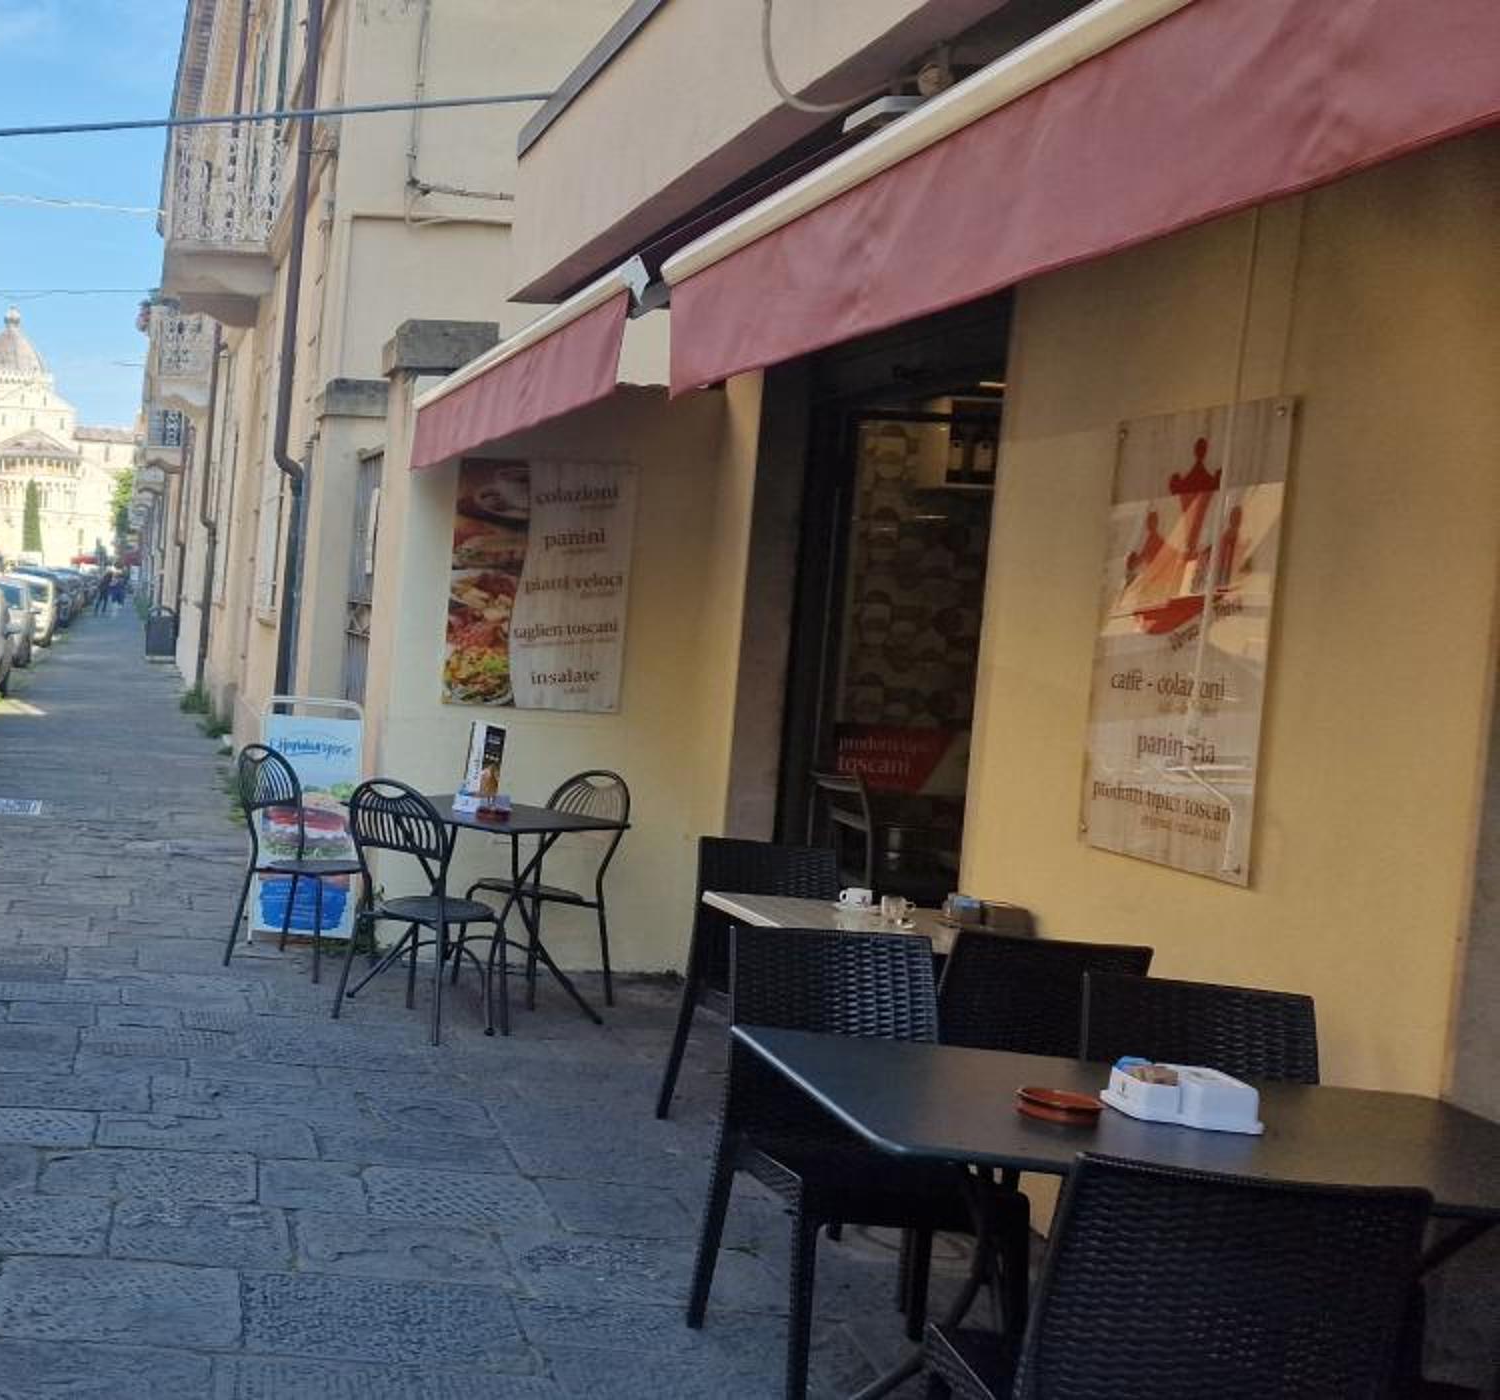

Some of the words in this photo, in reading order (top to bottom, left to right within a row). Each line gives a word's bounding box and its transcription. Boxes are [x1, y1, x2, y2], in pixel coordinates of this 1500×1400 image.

[535, 482, 619, 504] colazioni
[544, 528, 606, 551] panini
[524, 576, 569, 595] piatti
[574, 571, 623, 588] veloci
[567, 618, 618, 636] toscani
[531, 666, 601, 686] insalate
[837, 755, 911, 775] toscani
[1092, 780, 1143, 803] prodotti
[1184, 799, 1231, 824] toscan
